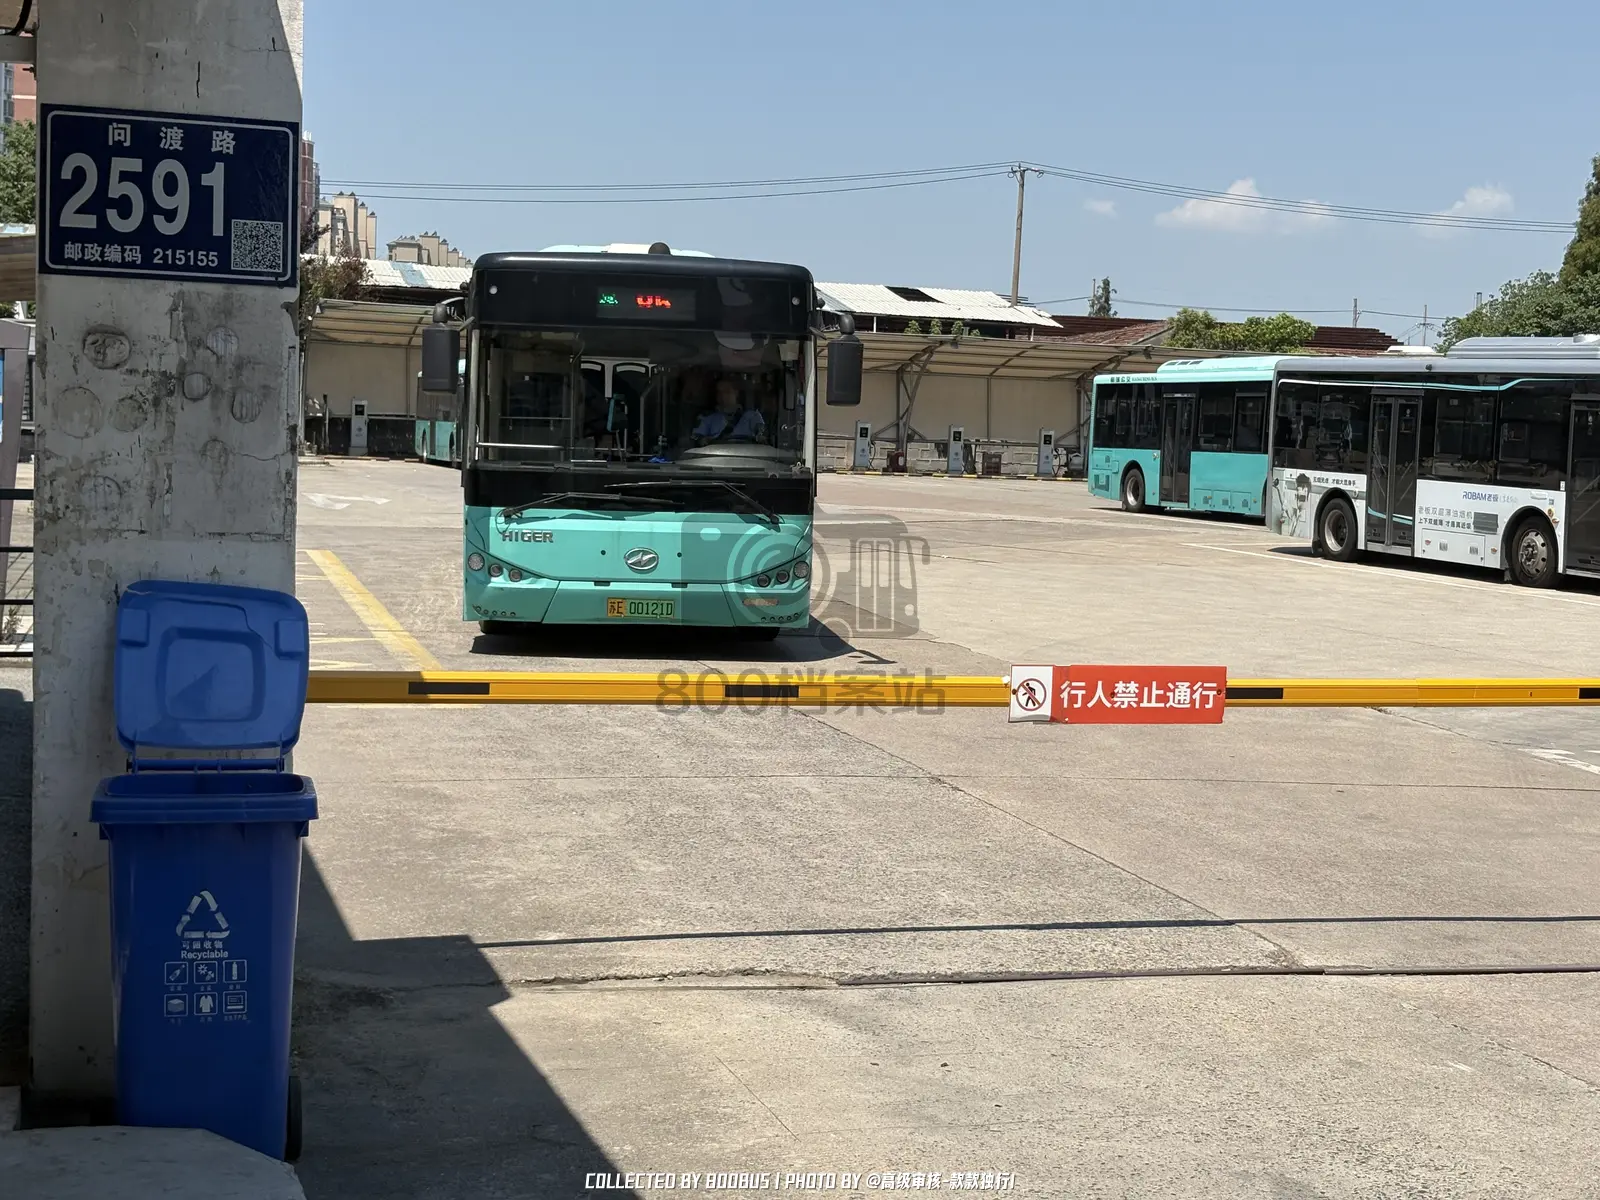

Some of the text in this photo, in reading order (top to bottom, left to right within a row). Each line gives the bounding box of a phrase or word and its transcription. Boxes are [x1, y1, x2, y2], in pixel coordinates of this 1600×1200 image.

[109, 123, 236, 155] 问渡路
[59, 153, 225, 236] 2591
[64, 242, 219, 268] 邮政编码 215155
[500, 529, 554, 543] HIGER
[1060, 680, 1218, 709] 行人禁止通行
[180, 949, 229, 961] Recyclable
